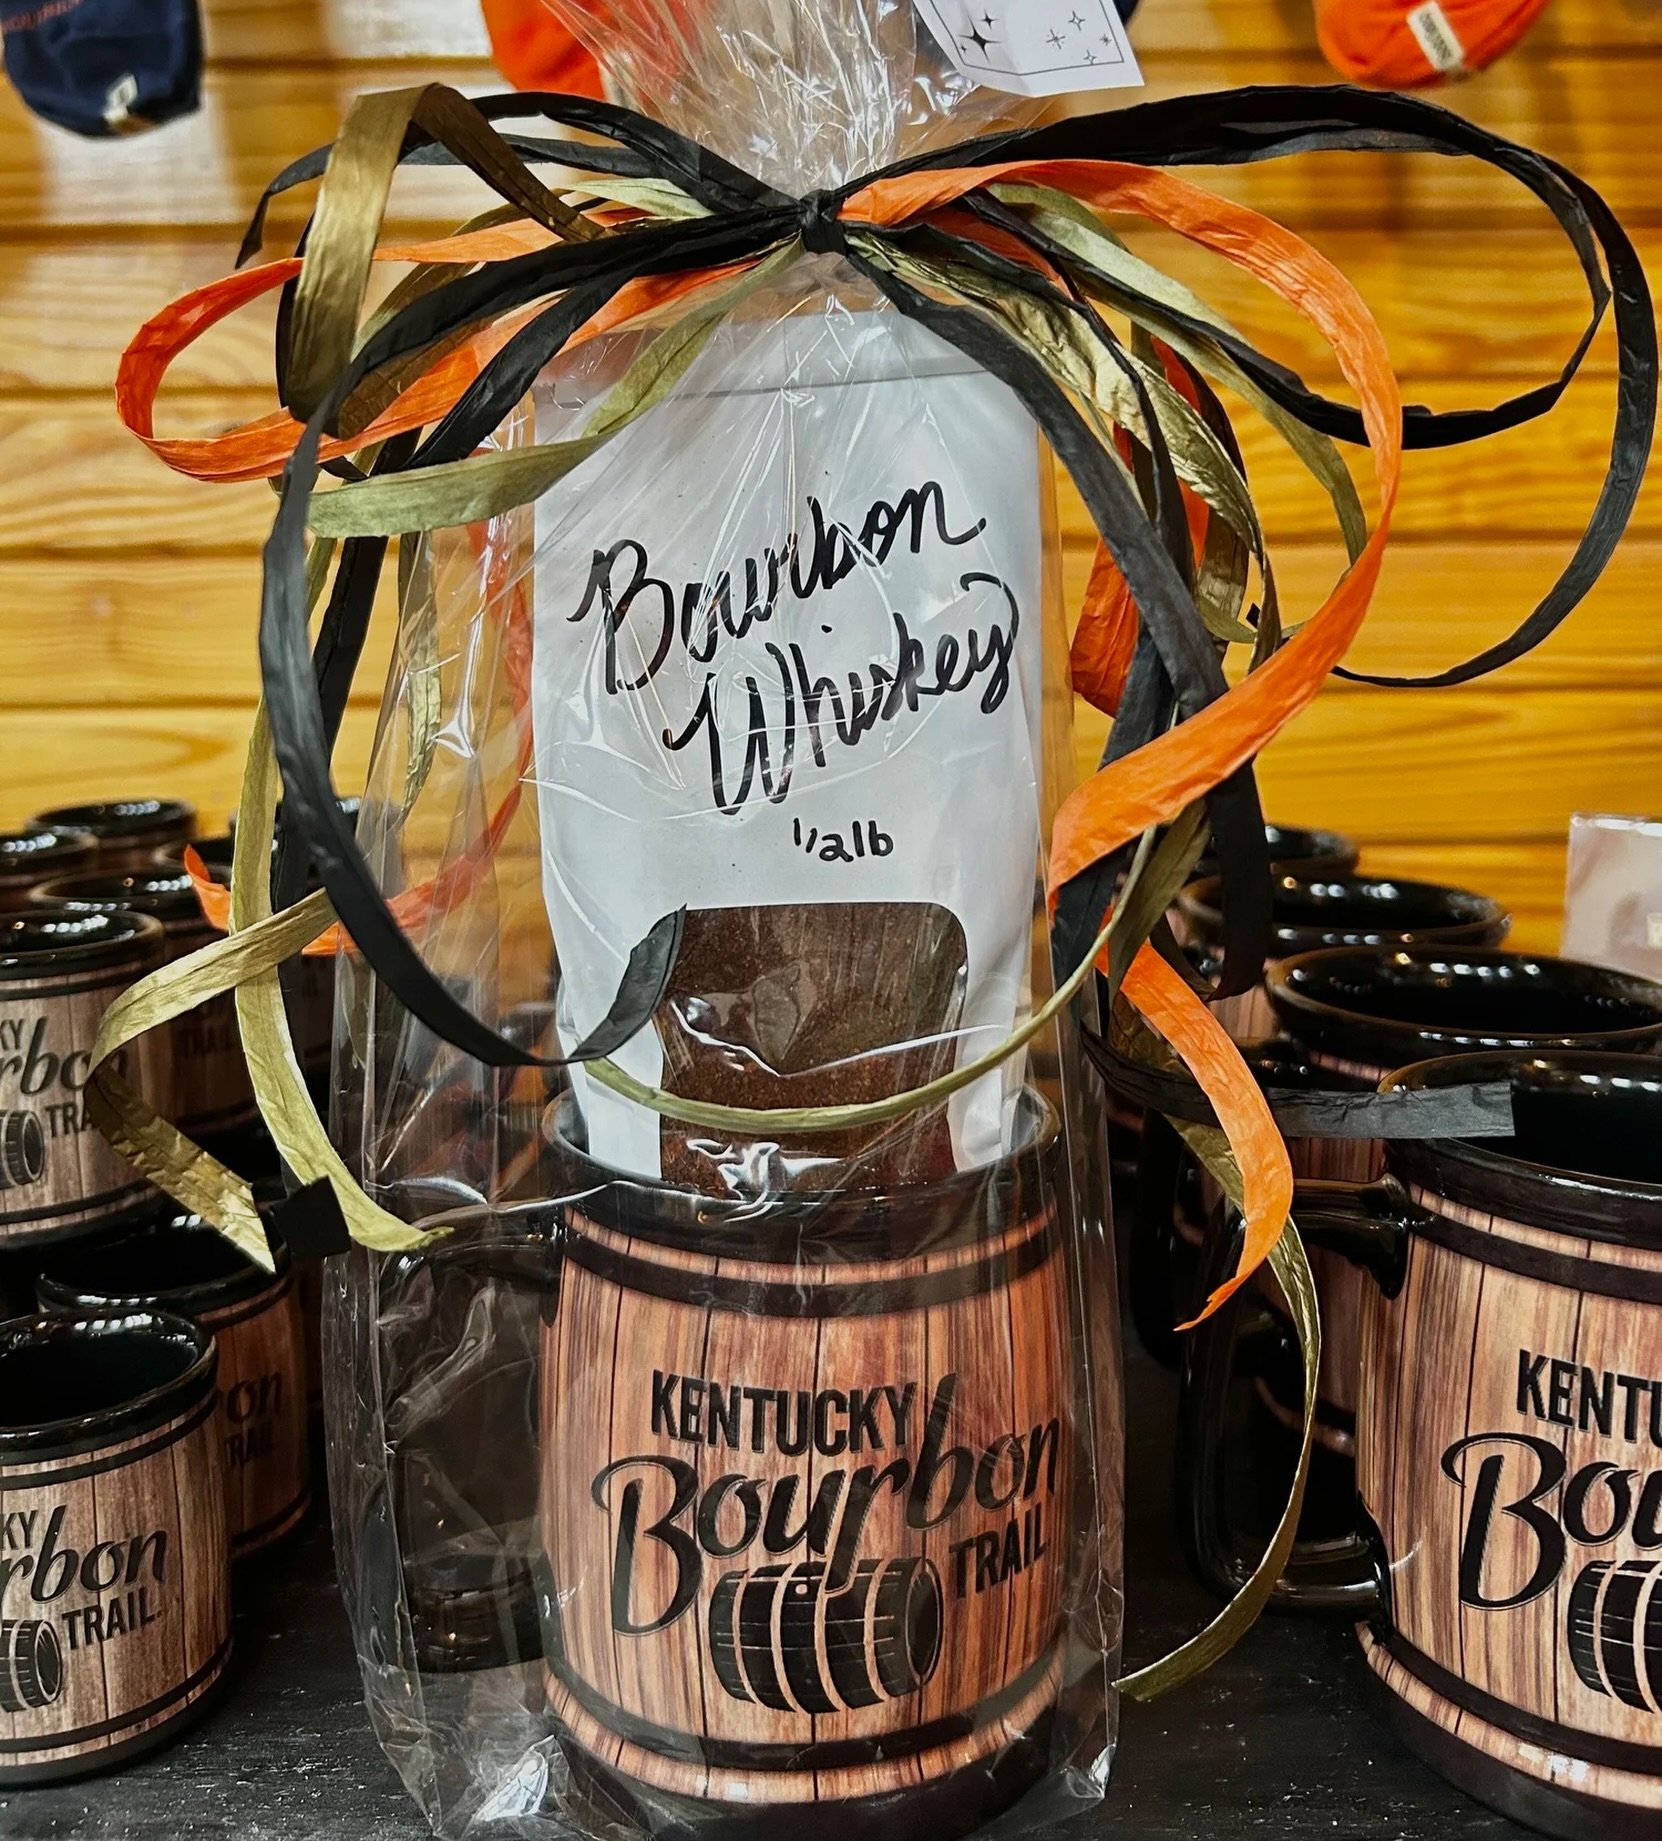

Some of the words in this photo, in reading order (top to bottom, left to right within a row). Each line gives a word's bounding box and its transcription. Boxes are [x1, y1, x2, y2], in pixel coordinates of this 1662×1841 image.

[566, 481, 986, 694] Bourbon
[662, 572, 1019, 815] Whiskey
[651, 1369, 917, 1457] KENTUCKY
[591, 1372, 1060, 1637] Bourbon
[949, 1503, 1045, 1599] TRAIL
[62, 1586, 158, 1651] TRAIL
